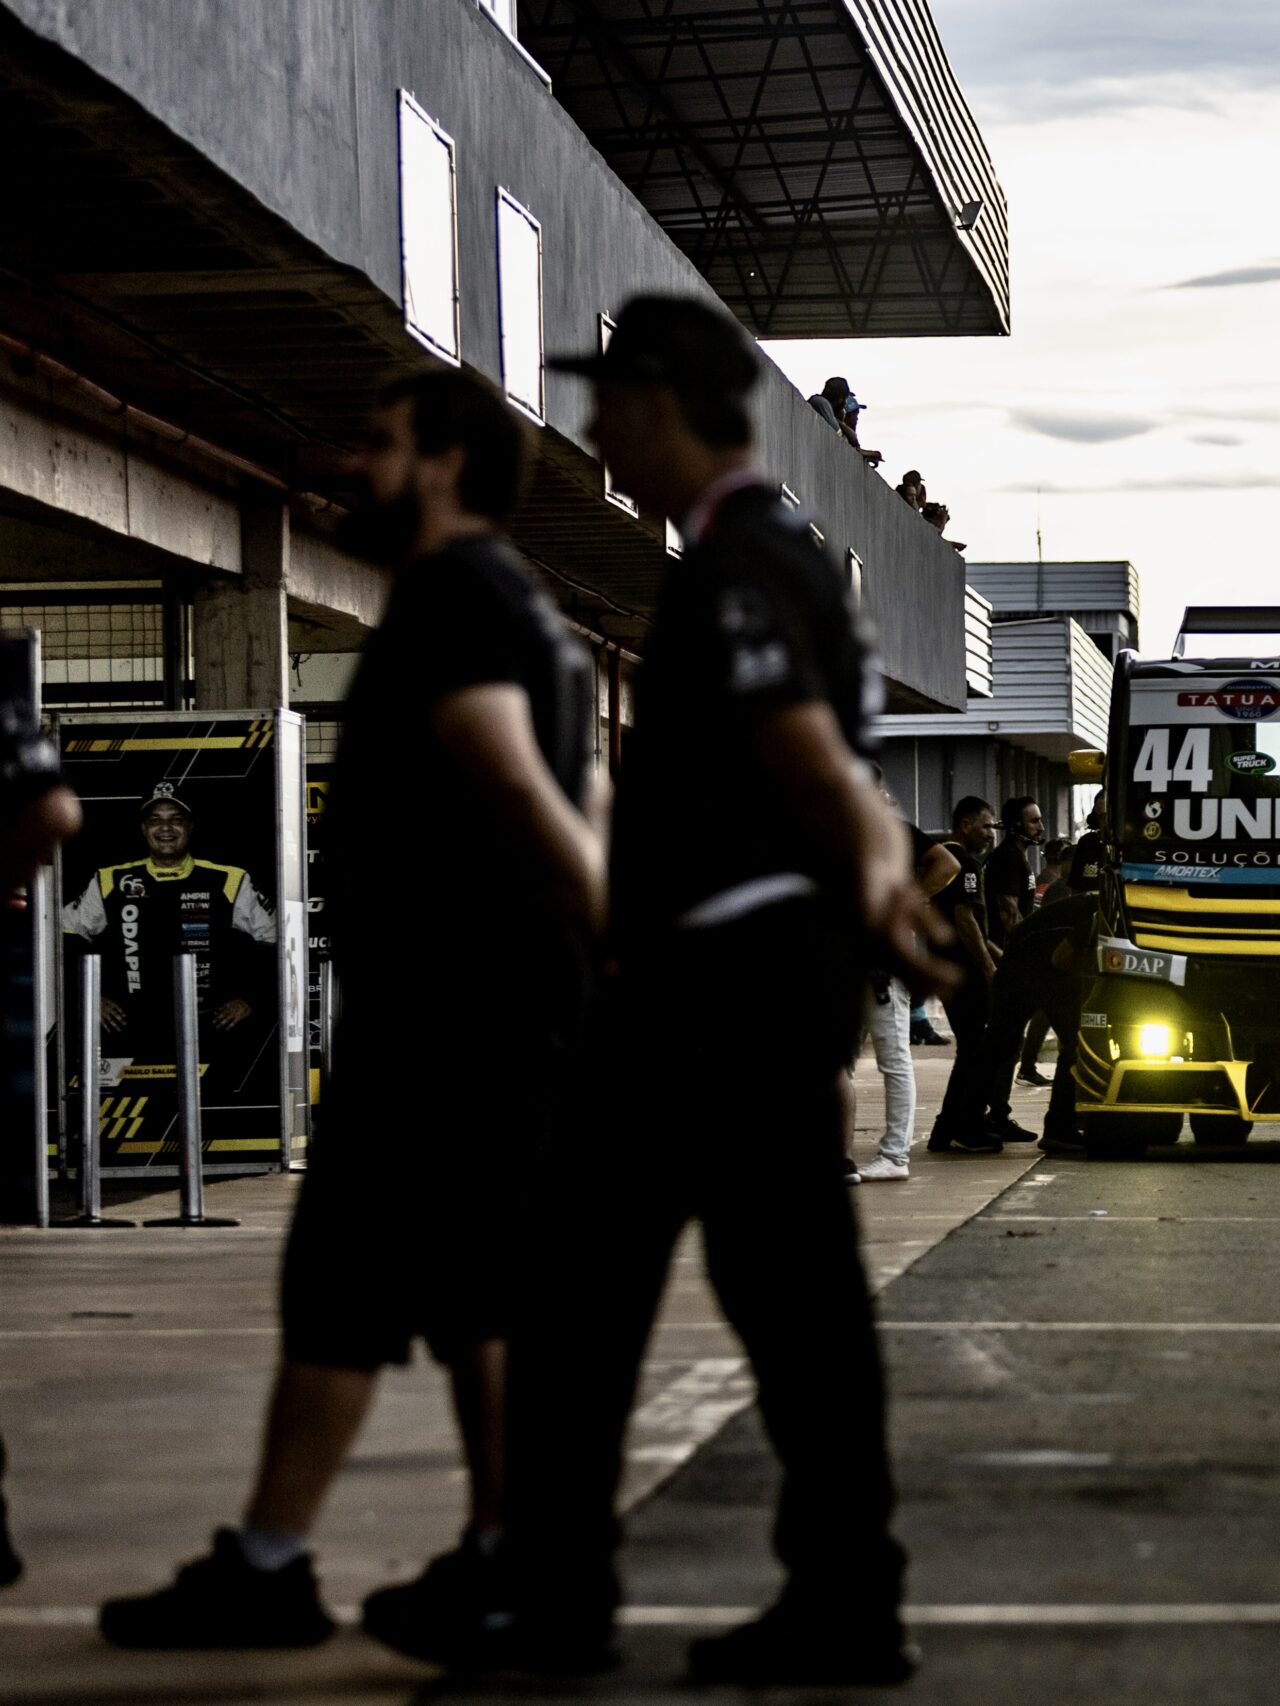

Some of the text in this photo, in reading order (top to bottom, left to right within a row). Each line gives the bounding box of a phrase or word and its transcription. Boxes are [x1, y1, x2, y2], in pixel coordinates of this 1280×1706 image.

[1133, 727, 1213, 793] 44
[1232, 754, 1256, 763] SUPER
[1236, 758, 1267, 769] TRUCK
[1154, 864, 1222, 878] AMORTEX
[121, 904, 142, 994] ODAPEL
[1124, 954, 1165, 973] DAP
